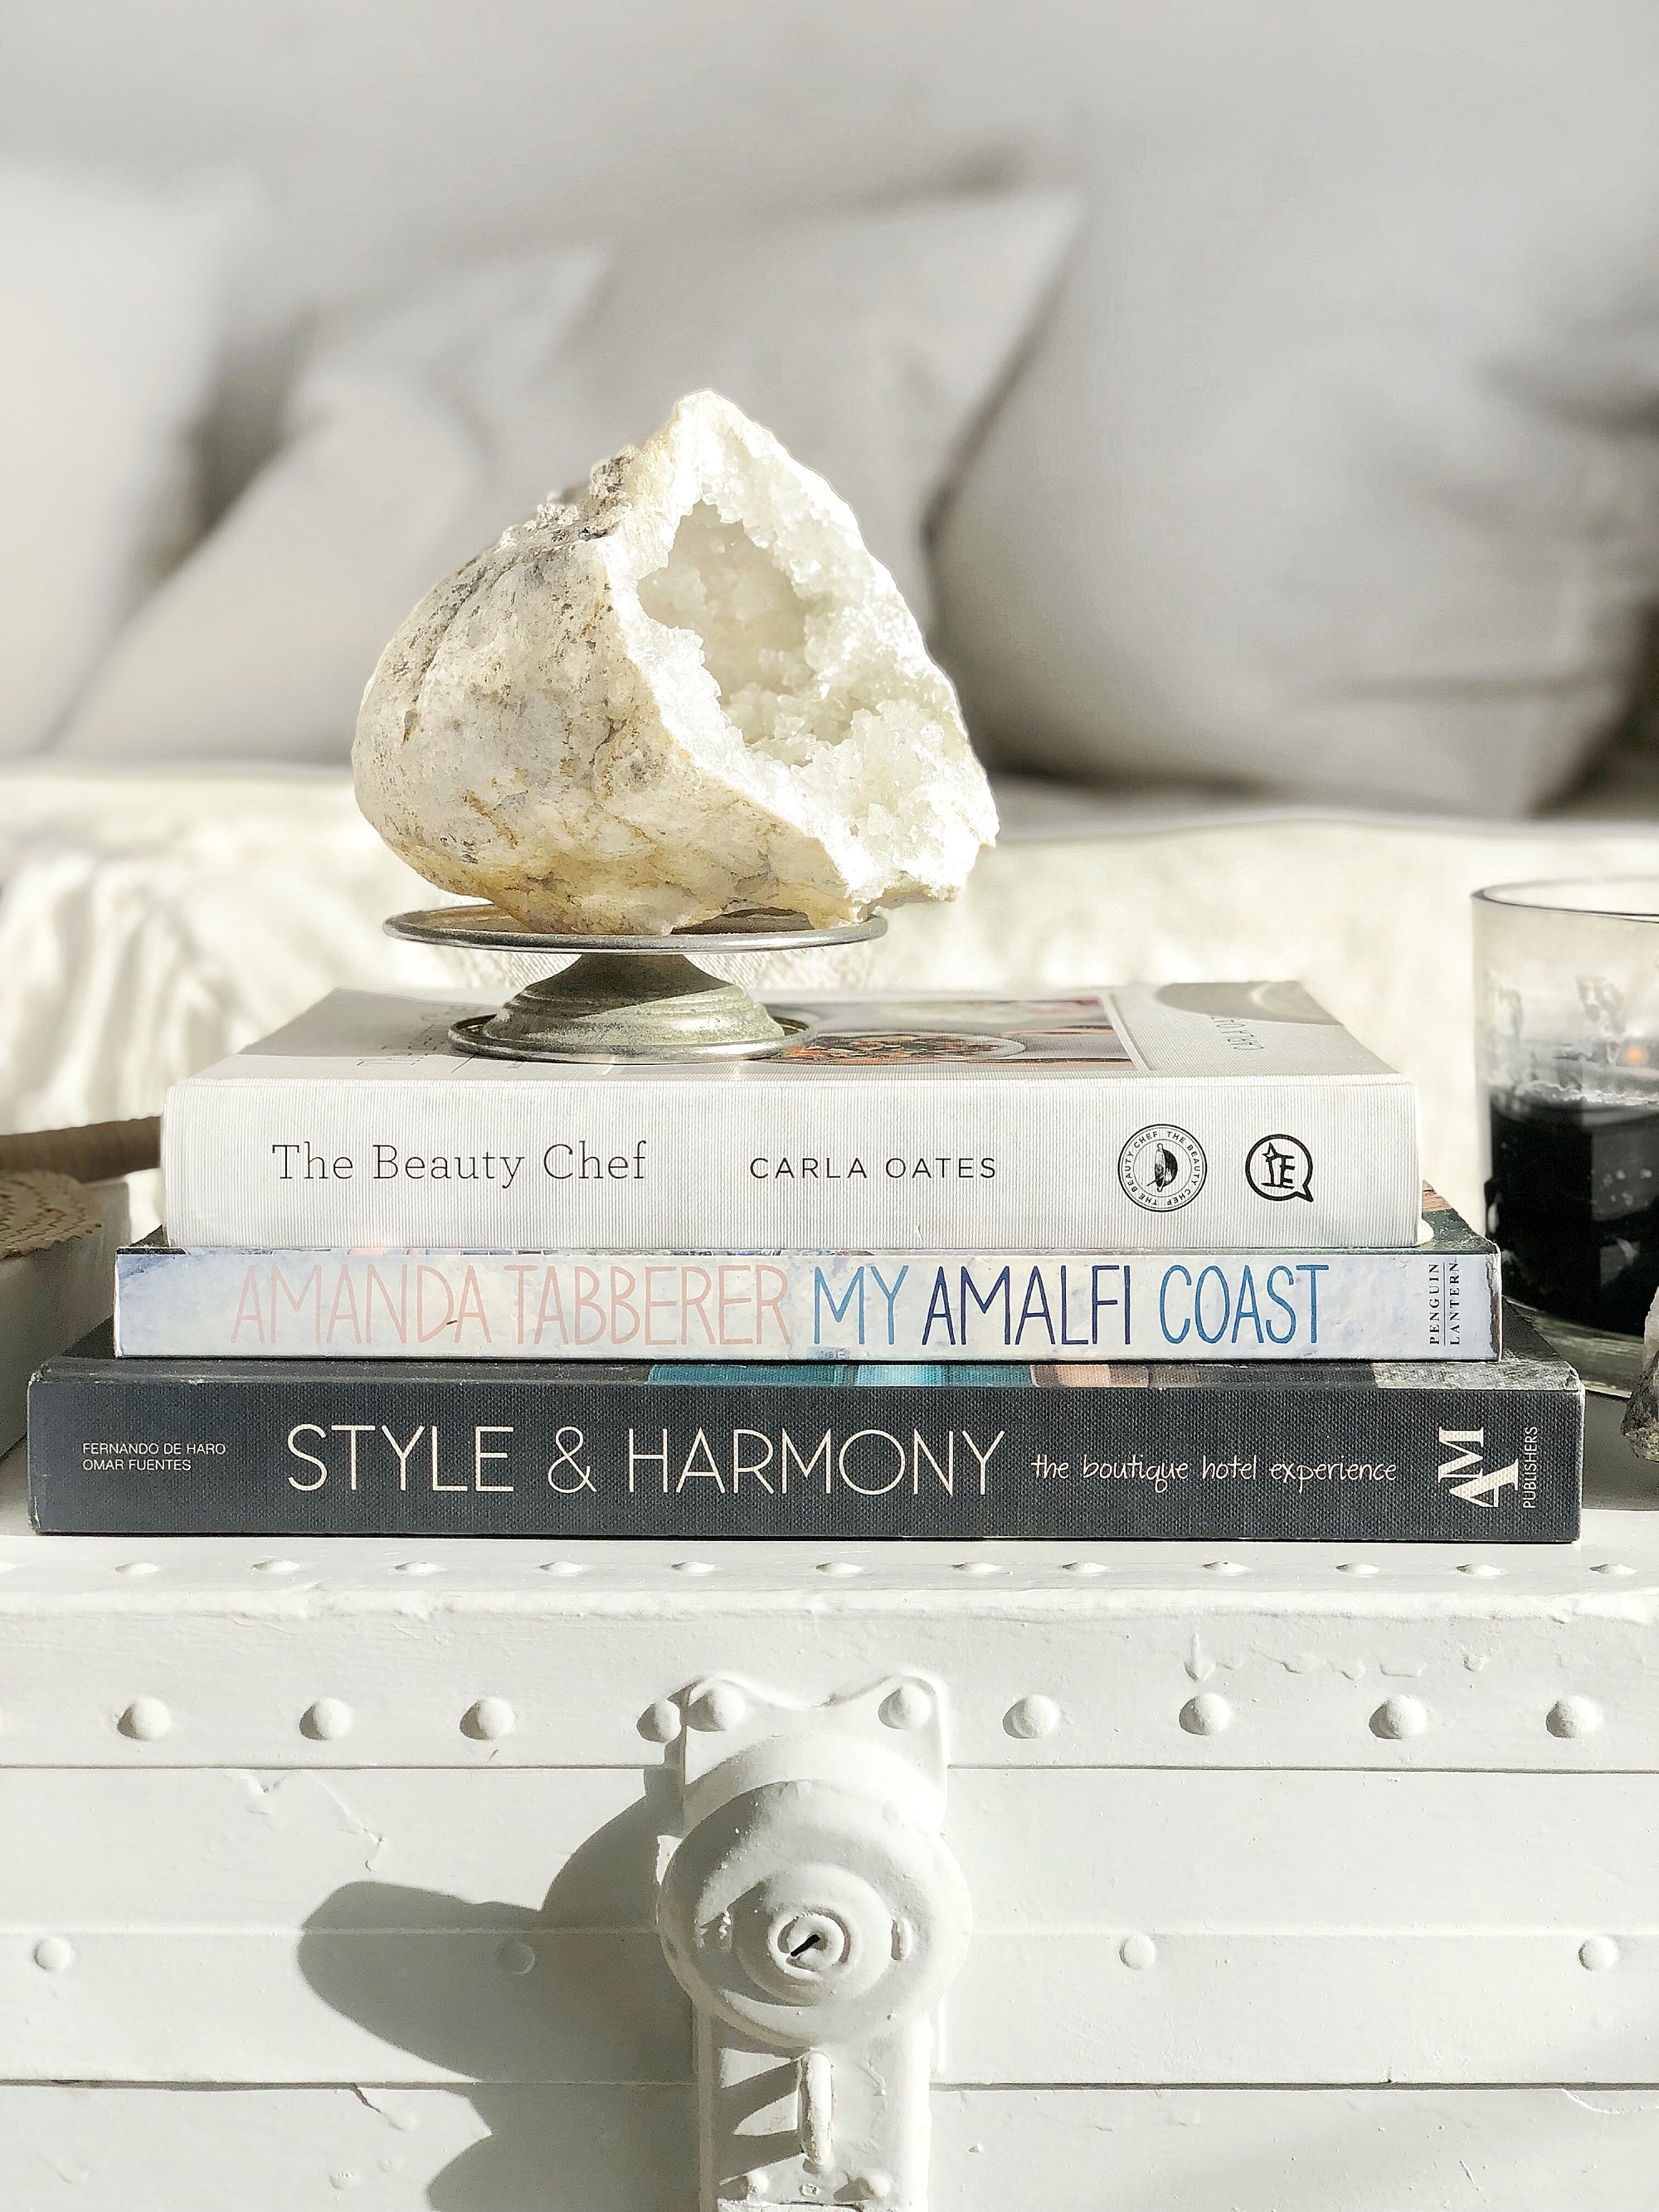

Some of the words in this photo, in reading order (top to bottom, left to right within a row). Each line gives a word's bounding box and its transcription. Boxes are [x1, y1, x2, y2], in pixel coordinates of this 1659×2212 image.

[1134, 1131, 1158, 1149] CHEF
[1167, 1131, 1186, 1144] THE
[272, 1140, 353, 1179] The
[372, 1145, 525, 1189] Beauty
[543, 1140, 647, 1179] Chef
[750, 1157, 868, 1179] CARLA
[885, 1157, 996, 1179] OATES
[1125, 1151, 1138, 1193] BEAUTY
[1187, 1145, 1200, 1186] BEAUTY
[1138, 1193, 1158, 1206] THE
[1167, 1189, 1191, 1206] CHEF
[231, 1264, 493, 1344] AMANDA
[504, 1263, 791, 1346] TABBERER
[813, 1265, 909, 1345] MY
[921, 1264, 1131, 1346] AMALFI
[1159, 1264, 1330, 1345] COAST
[1429, 1264, 1440, 1345] PENGUIN
[1449, 1262, 1460, 1345] LANTERN
[82, 1442, 159, 1455] FERNANDO
[163, 1442, 182, 1455] DE
[187, 1443, 226, 1455] HARO
[82, 1459, 124, 1471] OMAR
[129, 1459, 192, 1471] FUENTES
[287, 1423, 514, 1492] STYLE
[547, 1426, 598, 1495] &
[628, 1427, 1006, 1497] HARMONY
[1522, 1427, 1538, 1509] PUBLISHERS
[1030, 1453, 1070, 1480] the
[1082, 1453, 1190, 1493] boutique
[1202, 1454, 1257, 1480] hotel
[1268, 1455, 1398, 1493] experience
